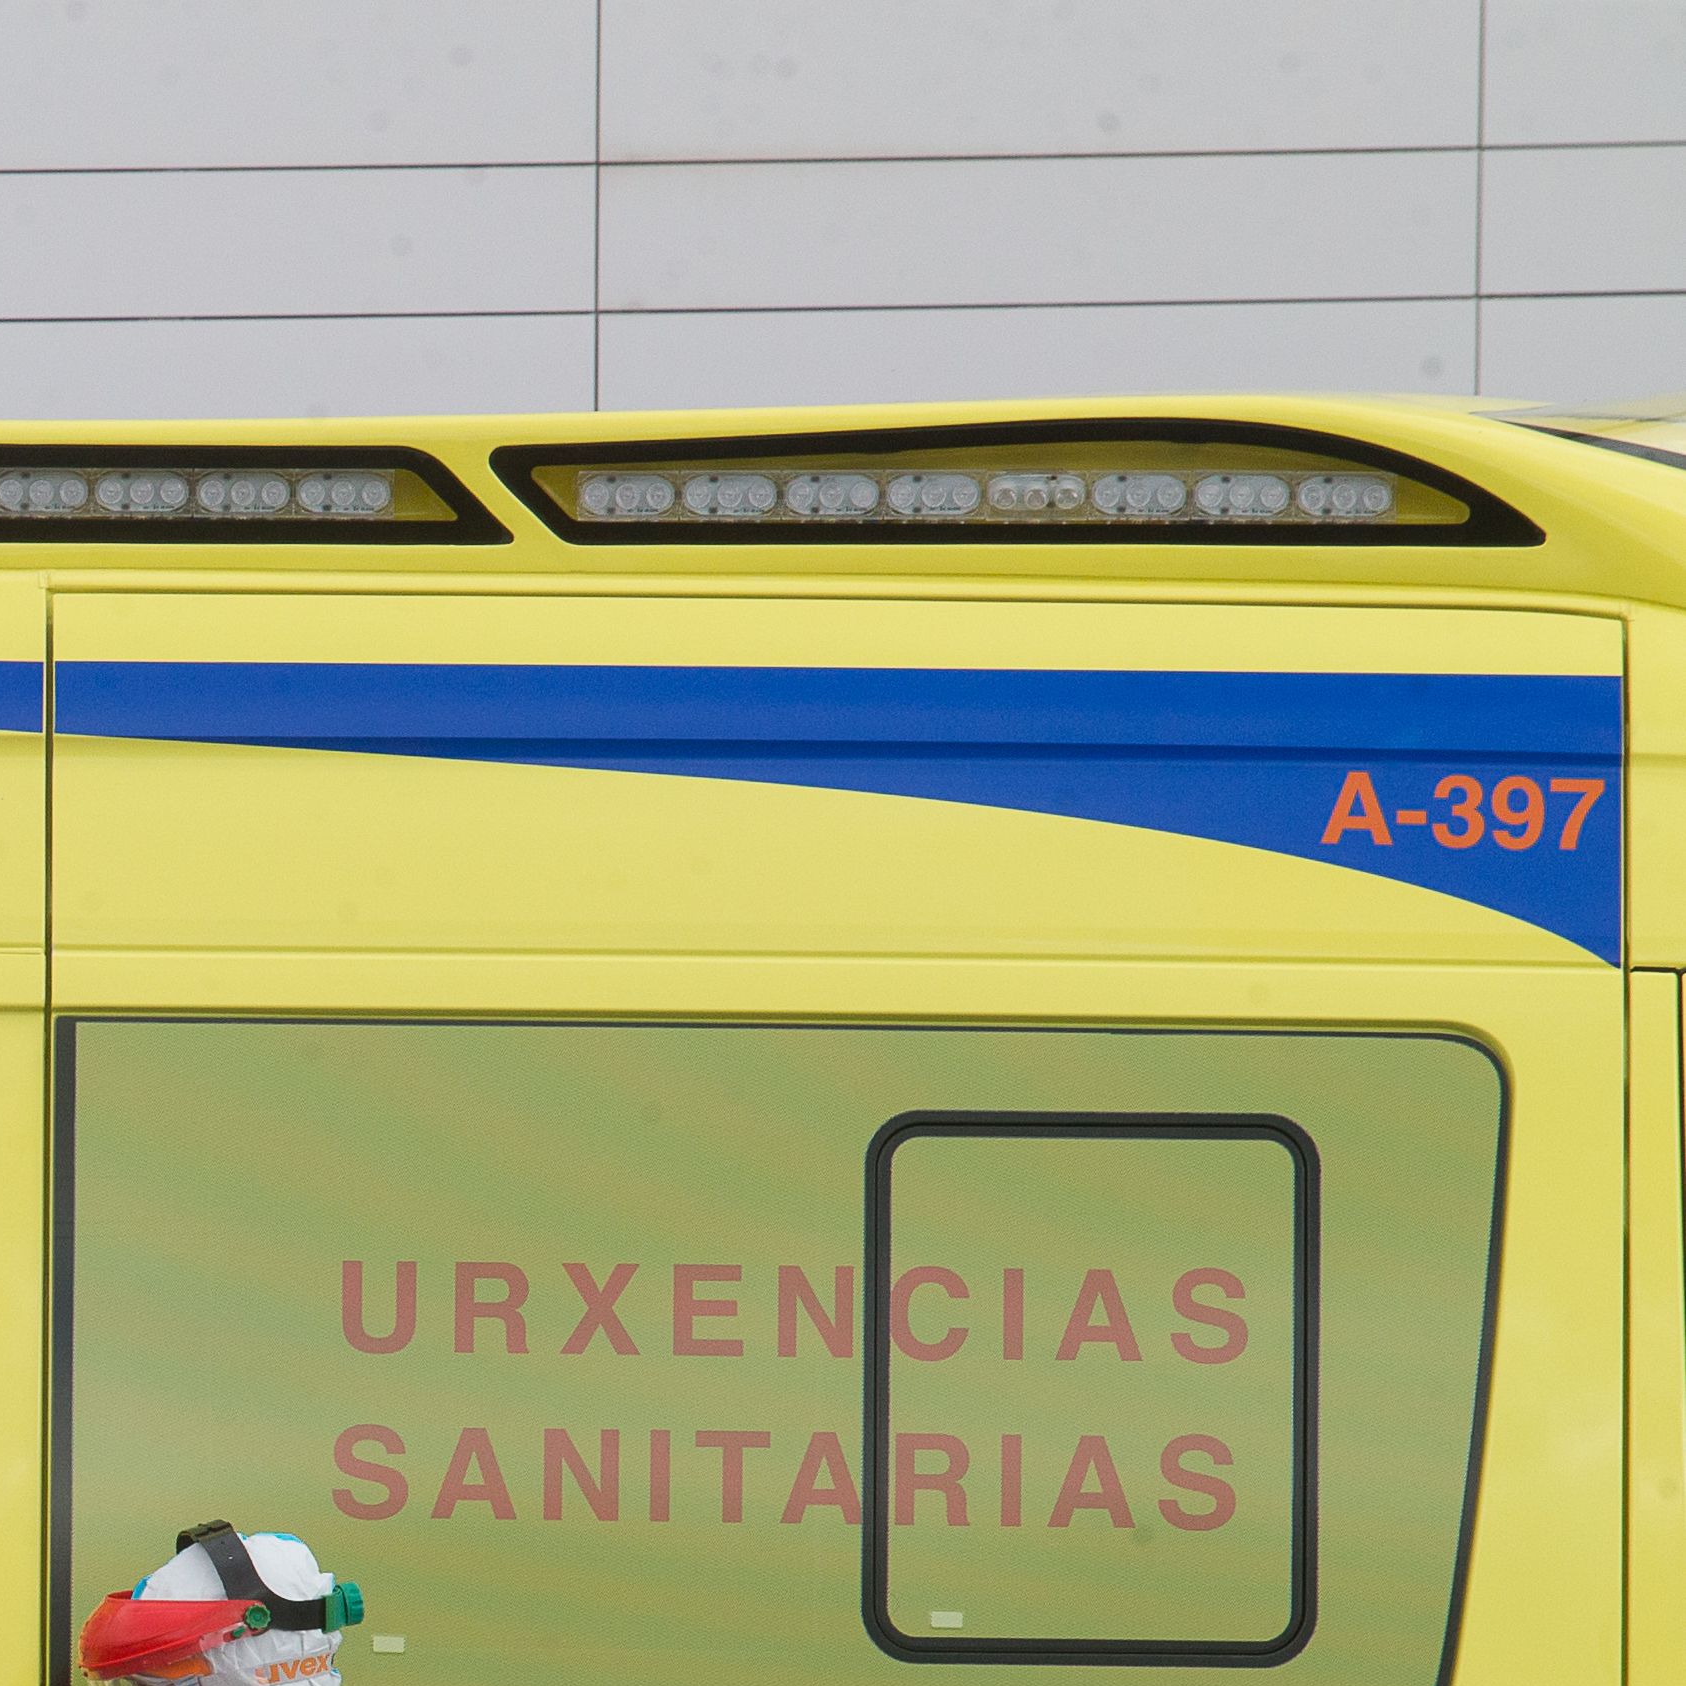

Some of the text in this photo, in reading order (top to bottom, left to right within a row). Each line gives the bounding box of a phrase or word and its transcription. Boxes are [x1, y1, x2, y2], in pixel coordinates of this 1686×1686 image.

[1321, 770, 1606, 851] A-397
[339, 1258, 1250, 1367] URXENCIAS
[330, 1423, 1239, 1533] SANITARIAS
[254, 1652, 331, 1685] uvex
